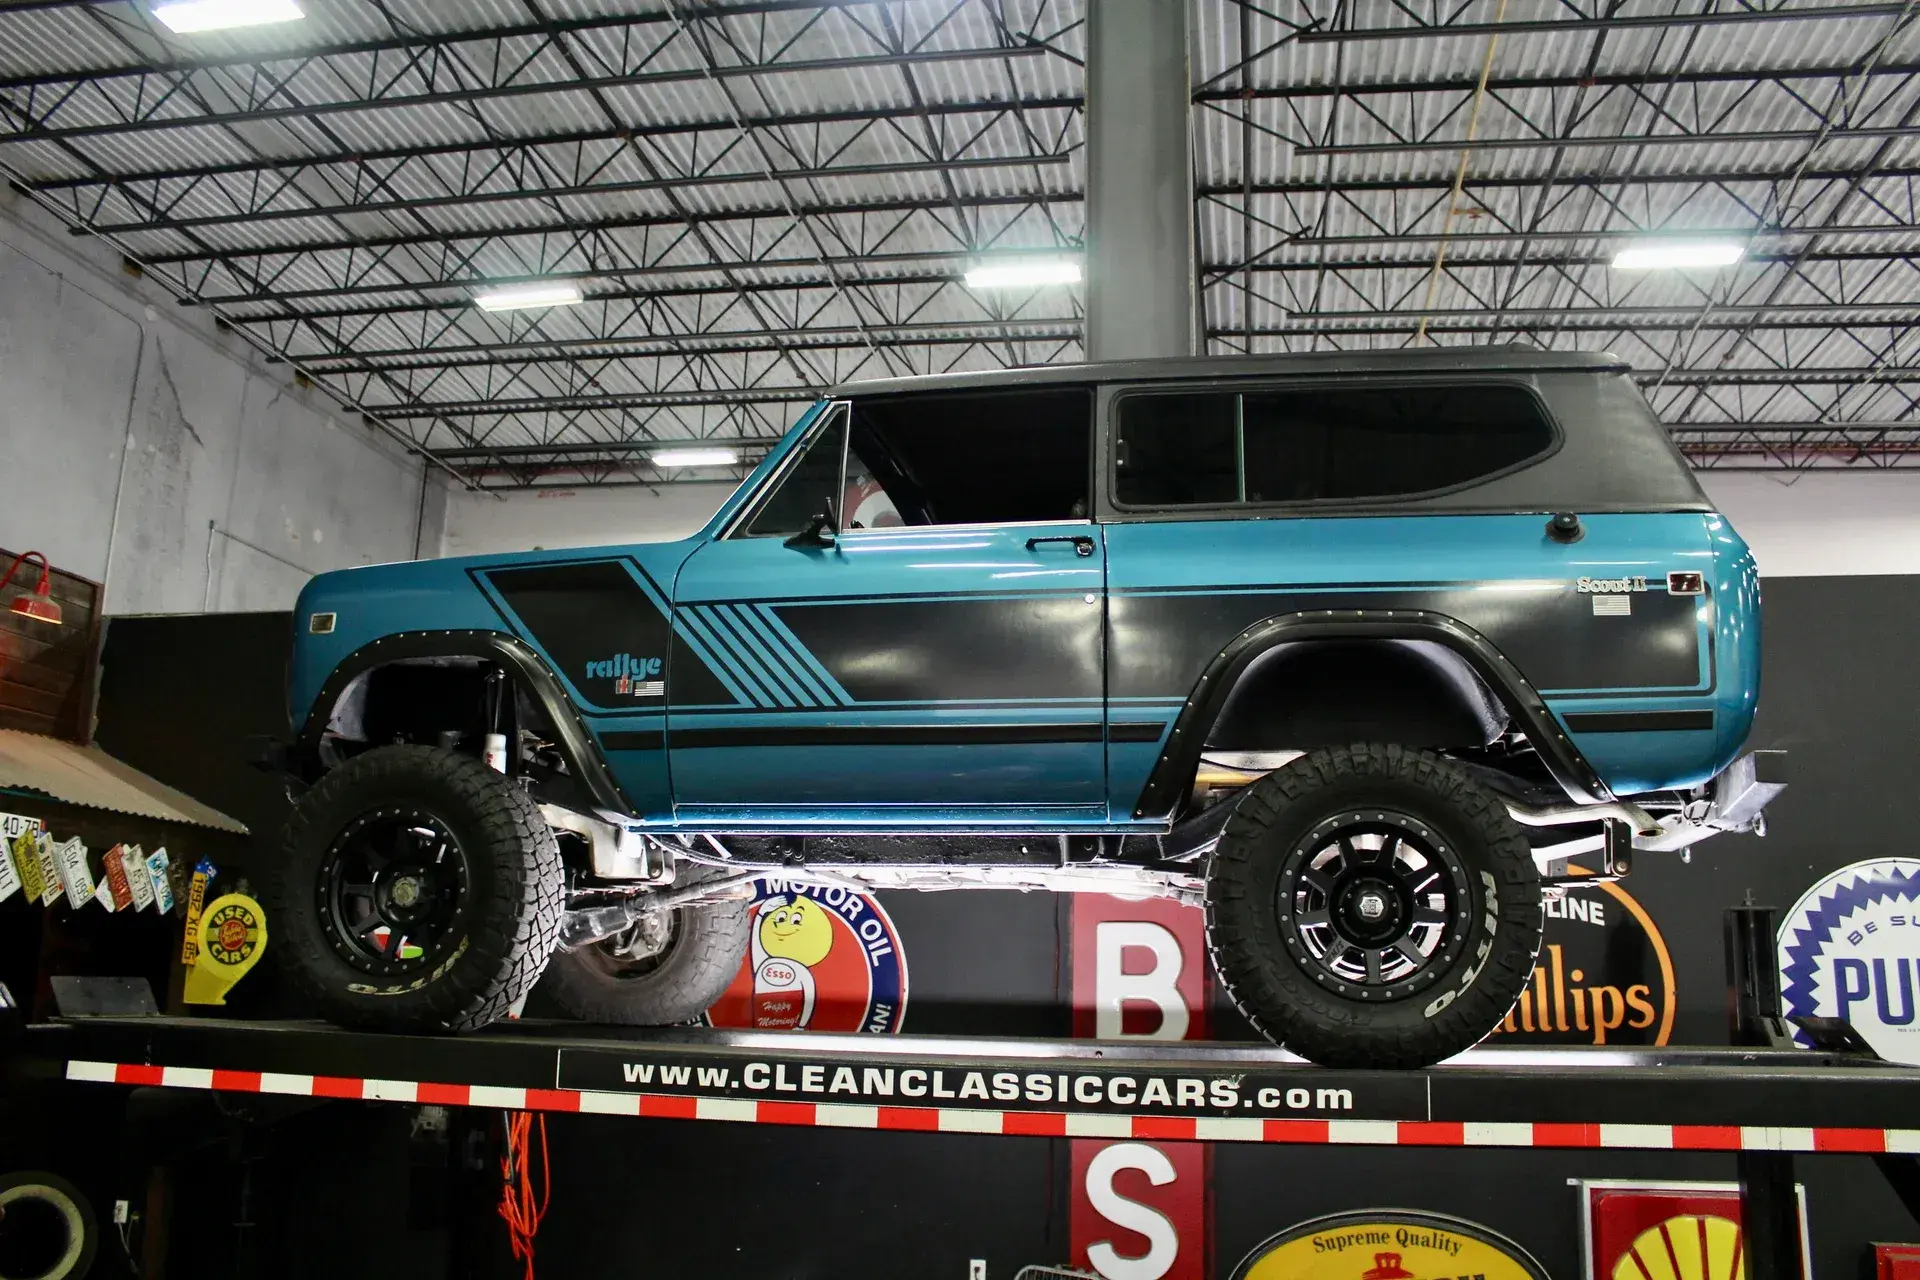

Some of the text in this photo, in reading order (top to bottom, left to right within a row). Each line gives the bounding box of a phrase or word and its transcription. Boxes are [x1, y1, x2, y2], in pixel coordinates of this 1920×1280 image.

[1577, 576, 1648, 593] Scout II
[586, 653, 662, 681] rallye
[213, 906, 255, 926] USED
[1546, 897, 1606, 927] LINE
[860, 919, 892, 968] OIL
[1847, 921, 1878, 947] BE
[211, 943, 252, 963] CARS
[1096, 921, 1190, 1041] B
[1833, 958, 1920, 1025] PU
[757, 1014, 800, 1027] Motoring!
[762, 1001, 792, 1013] Happy
[623, 1062, 1353, 1110] www.CLEANCLASSICCARS.com
[1086, 1143, 1179, 1280] S
[1312, 1228, 1464, 1257] Supreme Quality
